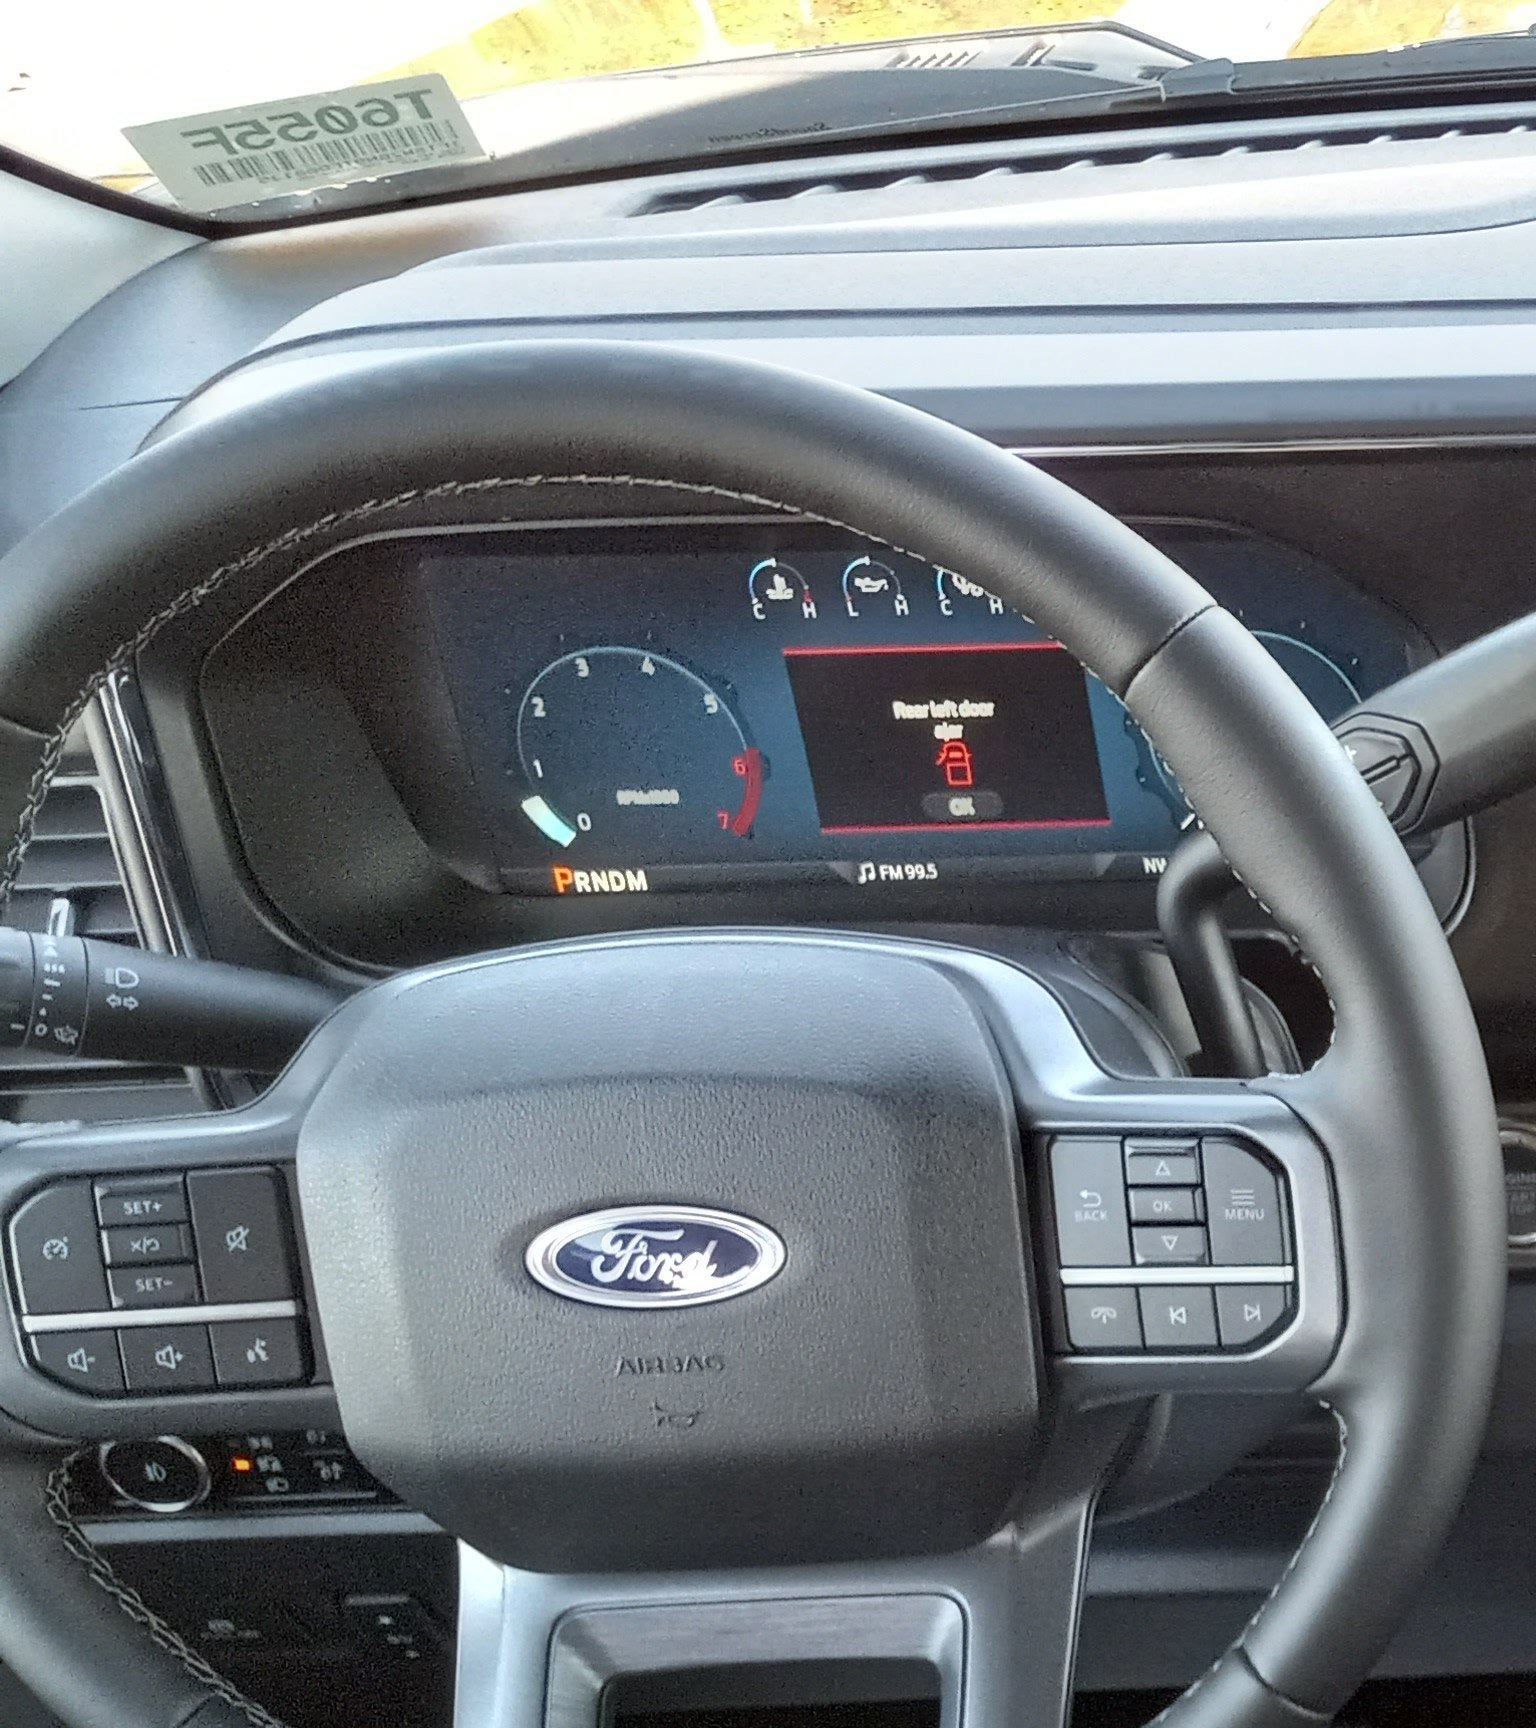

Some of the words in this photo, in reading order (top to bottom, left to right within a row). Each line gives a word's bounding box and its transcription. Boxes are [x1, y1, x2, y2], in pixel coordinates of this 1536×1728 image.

[576, 659, 590, 676] 3
[641, 659, 655, 676] 4
[531, 698, 546, 716] 2
[704, 696, 719, 713] 5
[892, 700, 929, 719] Rear
[958, 699, 995, 718] door
[577, 813, 592, 831] 0
[880, 864, 904, 883] FM
[907, 862, 938, 881] 99.5
[1153, 1200, 1172, 1212] OK
[1225, 1209, 1265, 1220] MENU
[1074, 1210, 1107, 1221] BACK
[590, 1228, 719, 1284] Ford
